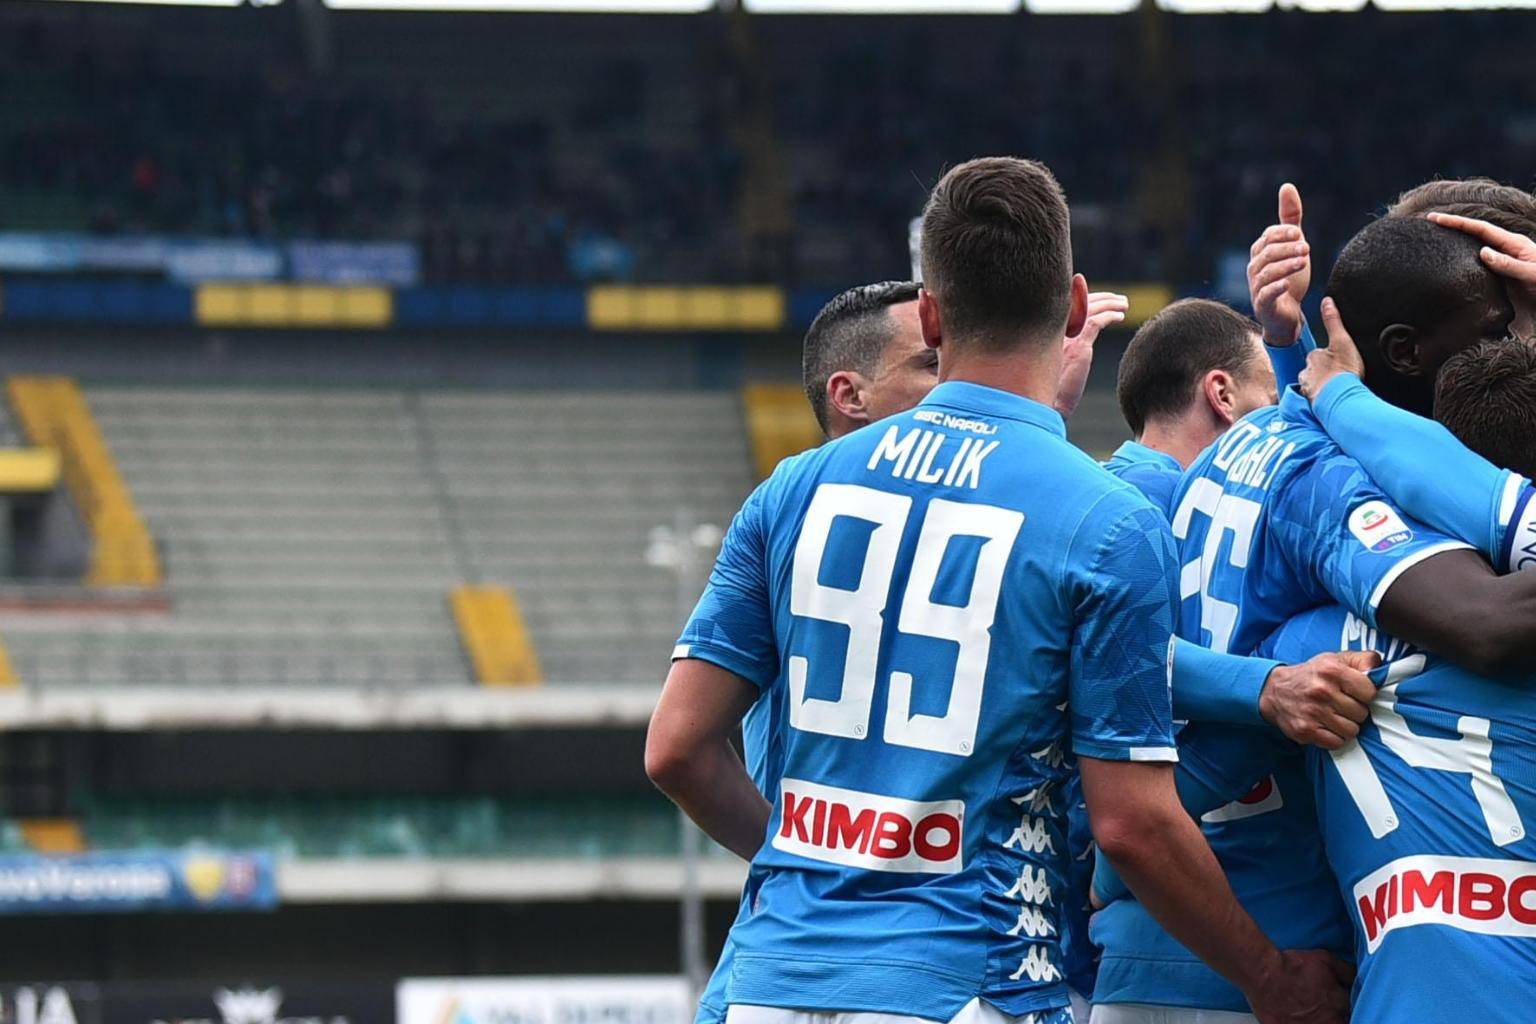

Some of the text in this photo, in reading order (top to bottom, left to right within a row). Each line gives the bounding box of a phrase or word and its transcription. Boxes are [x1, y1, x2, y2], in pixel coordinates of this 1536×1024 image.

[866, 424, 1001, 490] MILIK
[943, 415, 999, 435] NAPOLI
[788, 482, 1026, 757] 99
[780, 791, 961, 863] KIMBO
